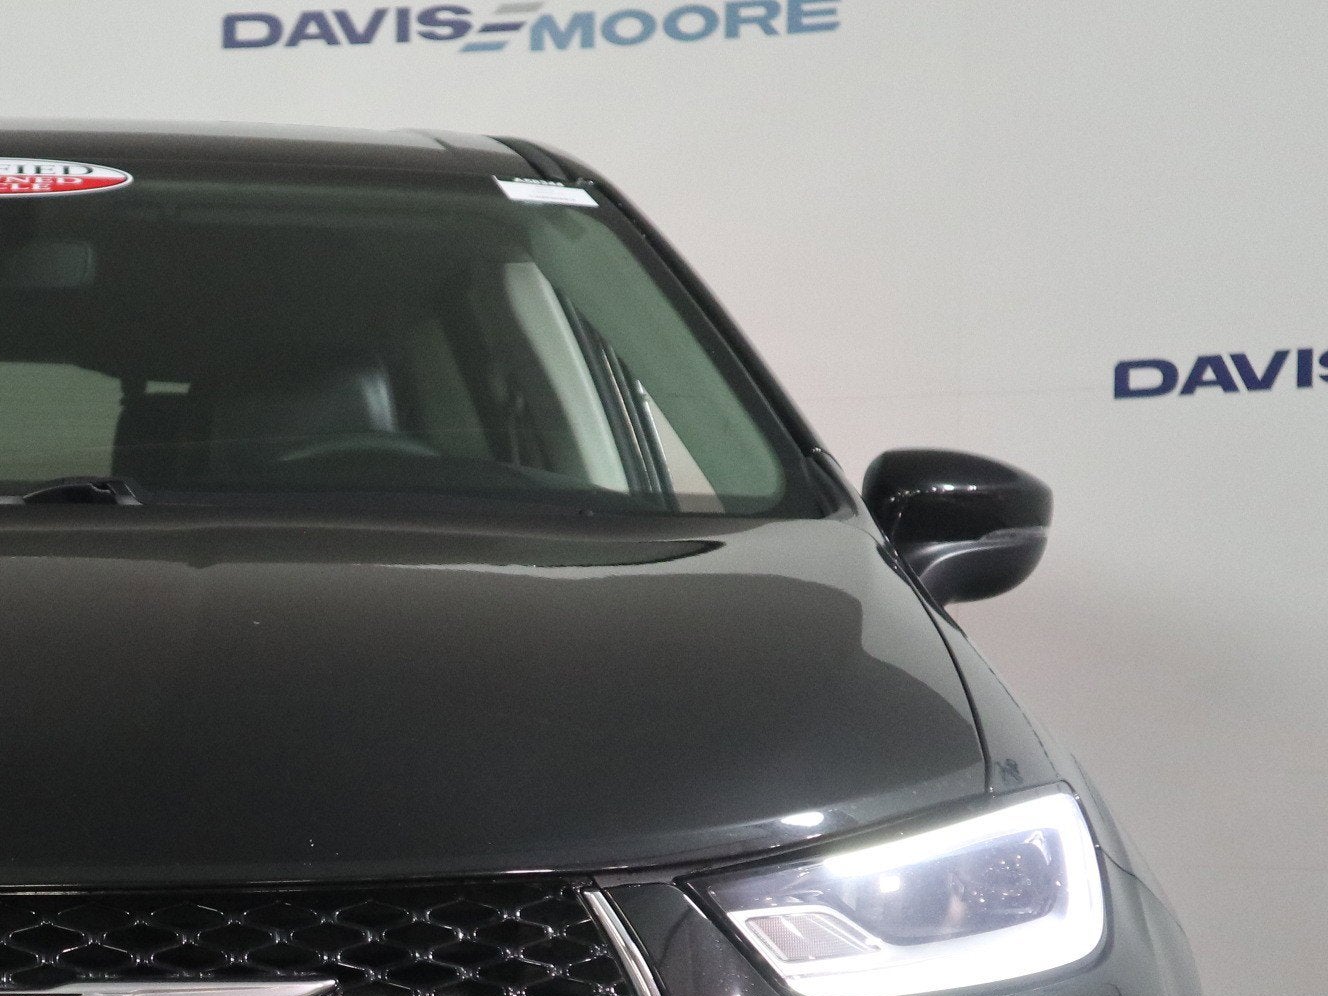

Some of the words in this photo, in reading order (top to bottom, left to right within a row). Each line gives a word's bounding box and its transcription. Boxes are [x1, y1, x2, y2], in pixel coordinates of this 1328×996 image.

[221, 4, 473, 50] DAVIS
[529, 0, 841, 51] MOORE
[1114, 348, 1328, 399] DAVI
